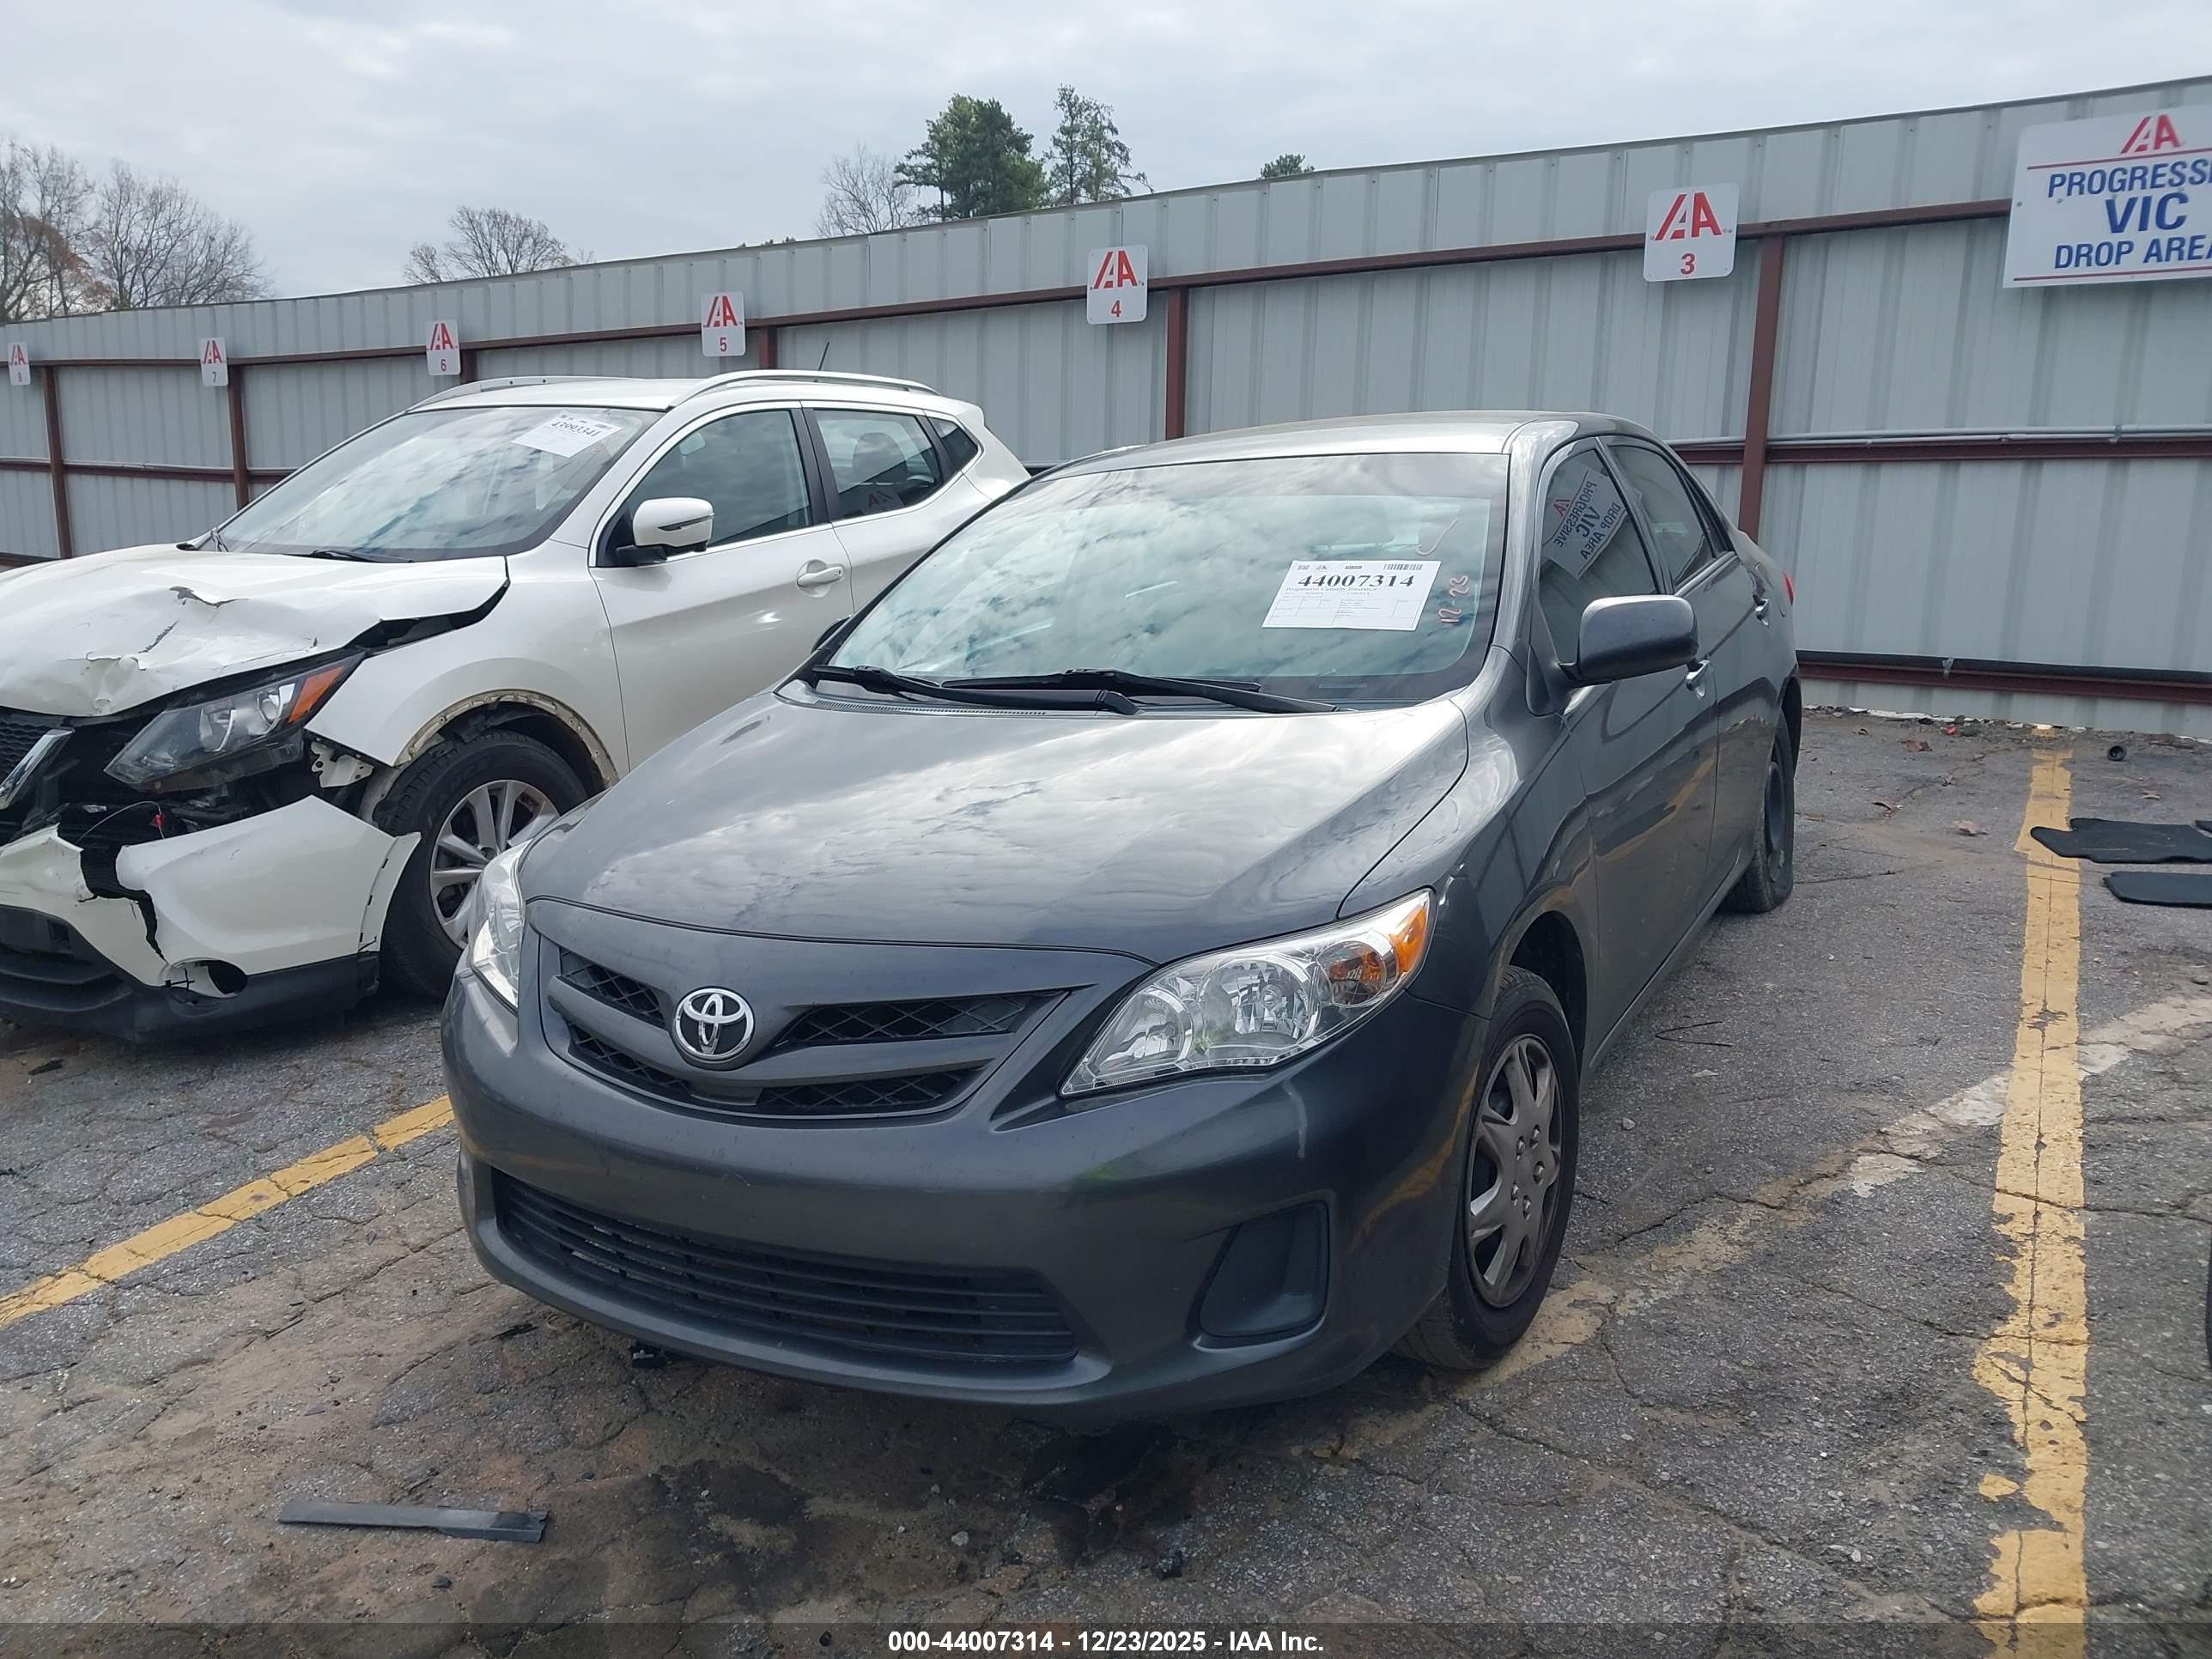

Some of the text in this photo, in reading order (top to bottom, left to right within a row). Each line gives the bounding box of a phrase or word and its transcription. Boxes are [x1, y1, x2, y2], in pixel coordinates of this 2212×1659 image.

[2105, 191, 2189, 234] VIC
[2054, 234, 2212, 270] DROP ARE
[1680, 252, 1696, 275] 3
[1110, 299, 1121, 318] 4
[719, 337, 727, 353] 5
[440, 358, 447, 373] 6
[211, 371, 218, 384] 7
[1297, 574, 1415, 587] 44007314
